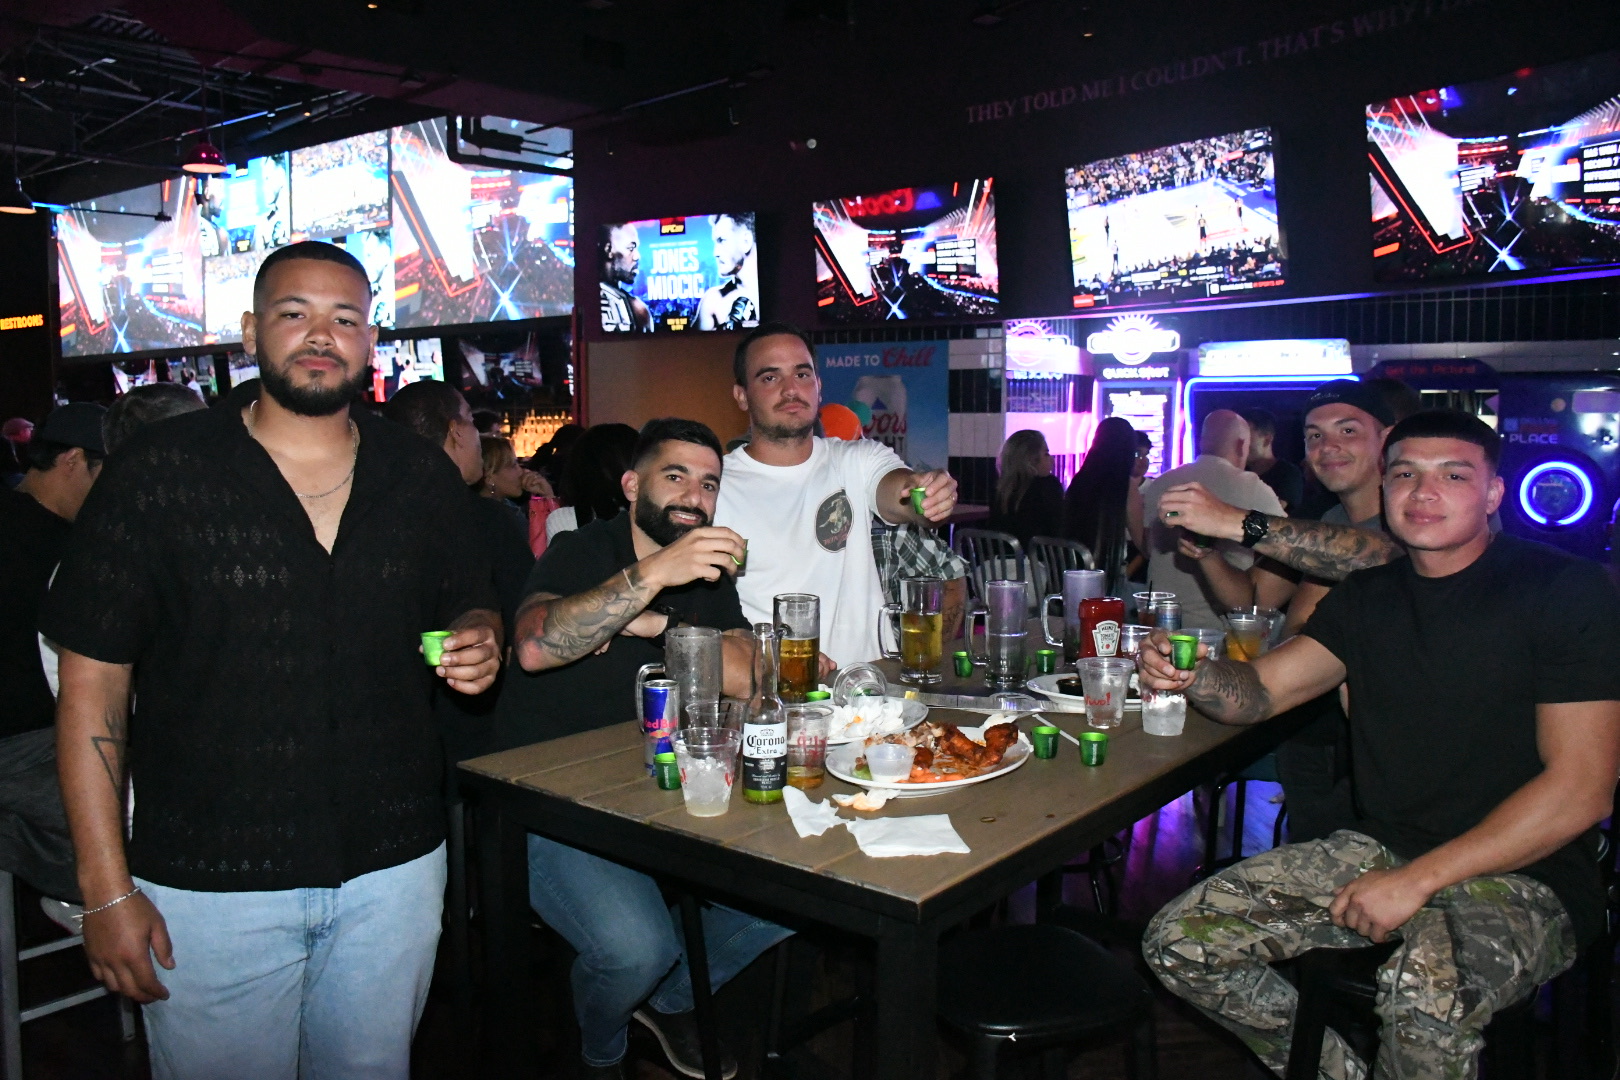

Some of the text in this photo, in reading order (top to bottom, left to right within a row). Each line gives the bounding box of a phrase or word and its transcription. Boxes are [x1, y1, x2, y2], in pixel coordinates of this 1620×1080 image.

[966, 99, 1017, 124] THEY
[1020, 86, 1077, 114] TOLD
[1082, 80, 1113, 101] ME
[650, 246, 699, 274] JONES
[647, 273, 705, 300] MIOCIC
[826, 346, 936, 368] MADE TO Chill
[1509, 433, 1558, 444] PLACE
[747, 735, 786, 749] Corona
[756, 747, 778, 755] Extra
